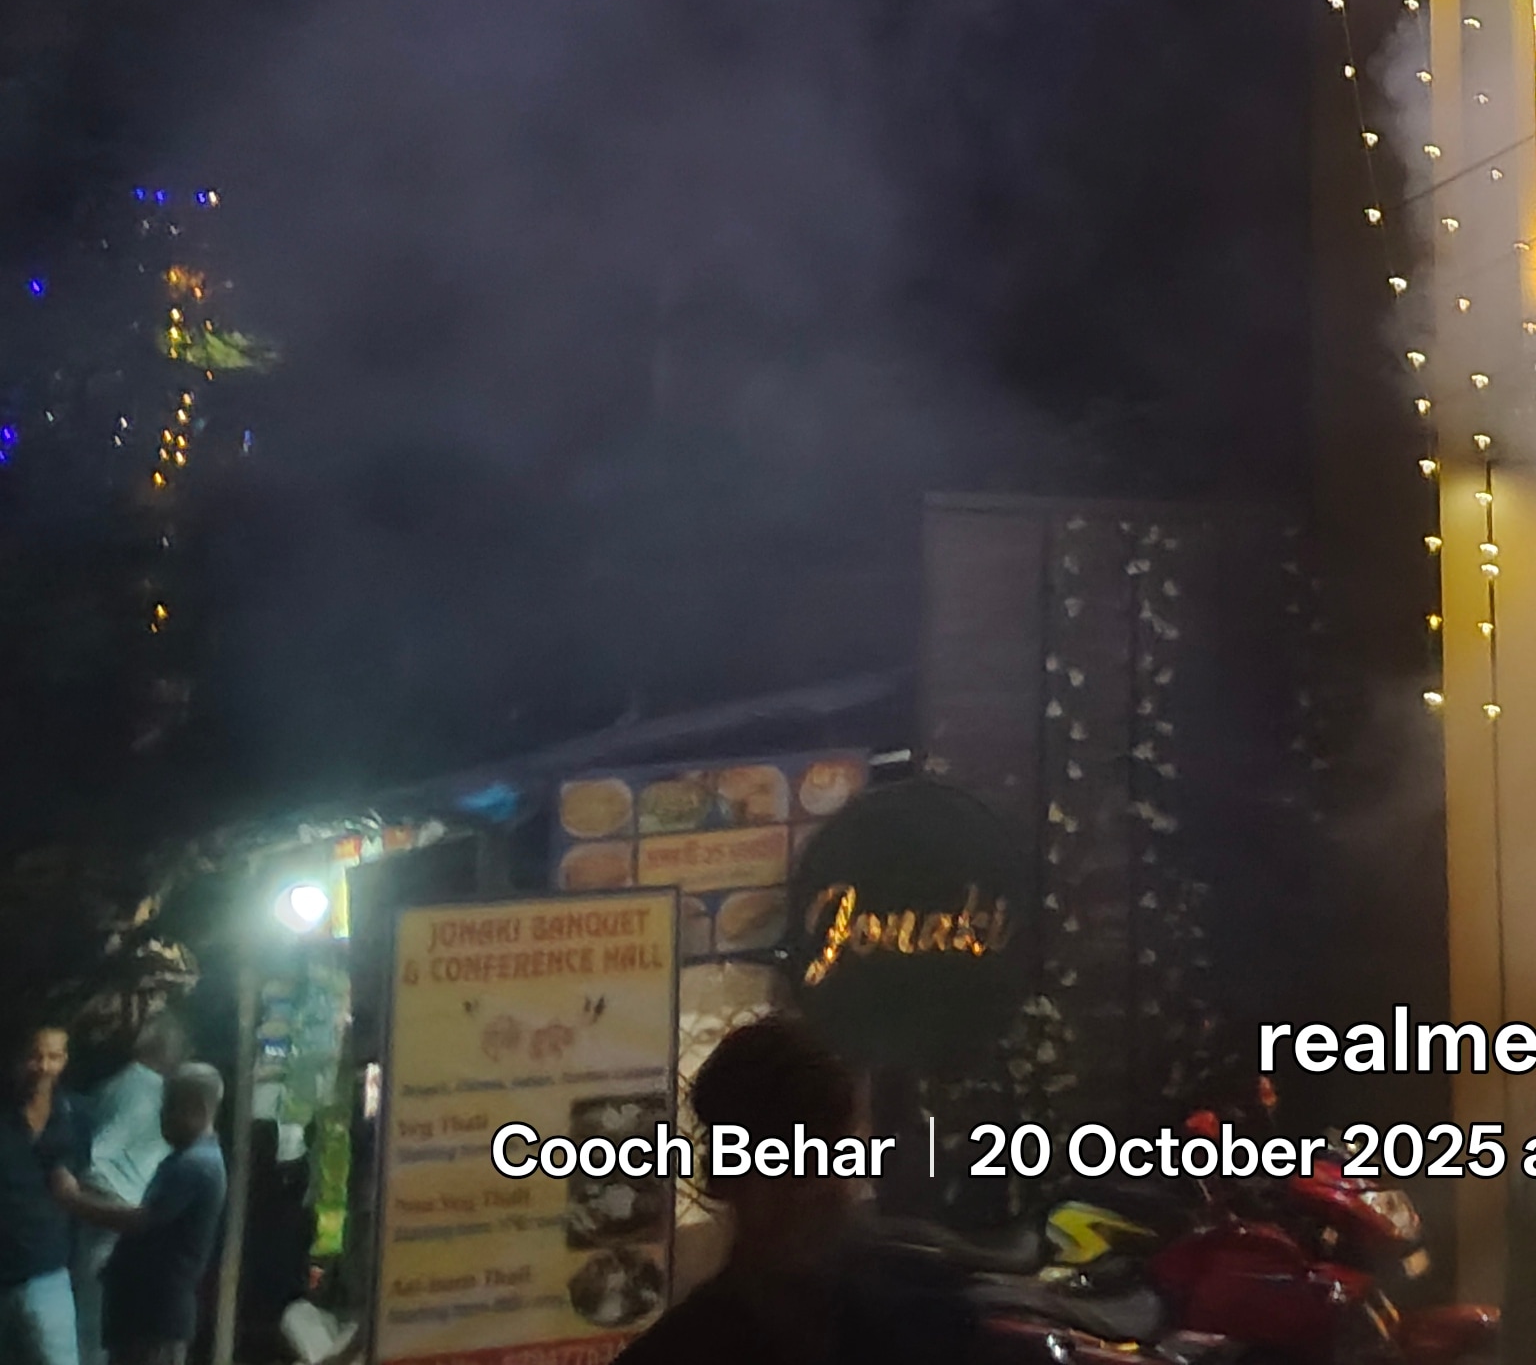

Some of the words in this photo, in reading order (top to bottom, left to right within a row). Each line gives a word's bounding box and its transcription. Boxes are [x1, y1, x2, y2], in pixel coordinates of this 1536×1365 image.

[430, 946, 595, 984] CONFERENCE
[602, 941, 664, 975] HALL
[803, 882, 1013, 987] Jonaki
